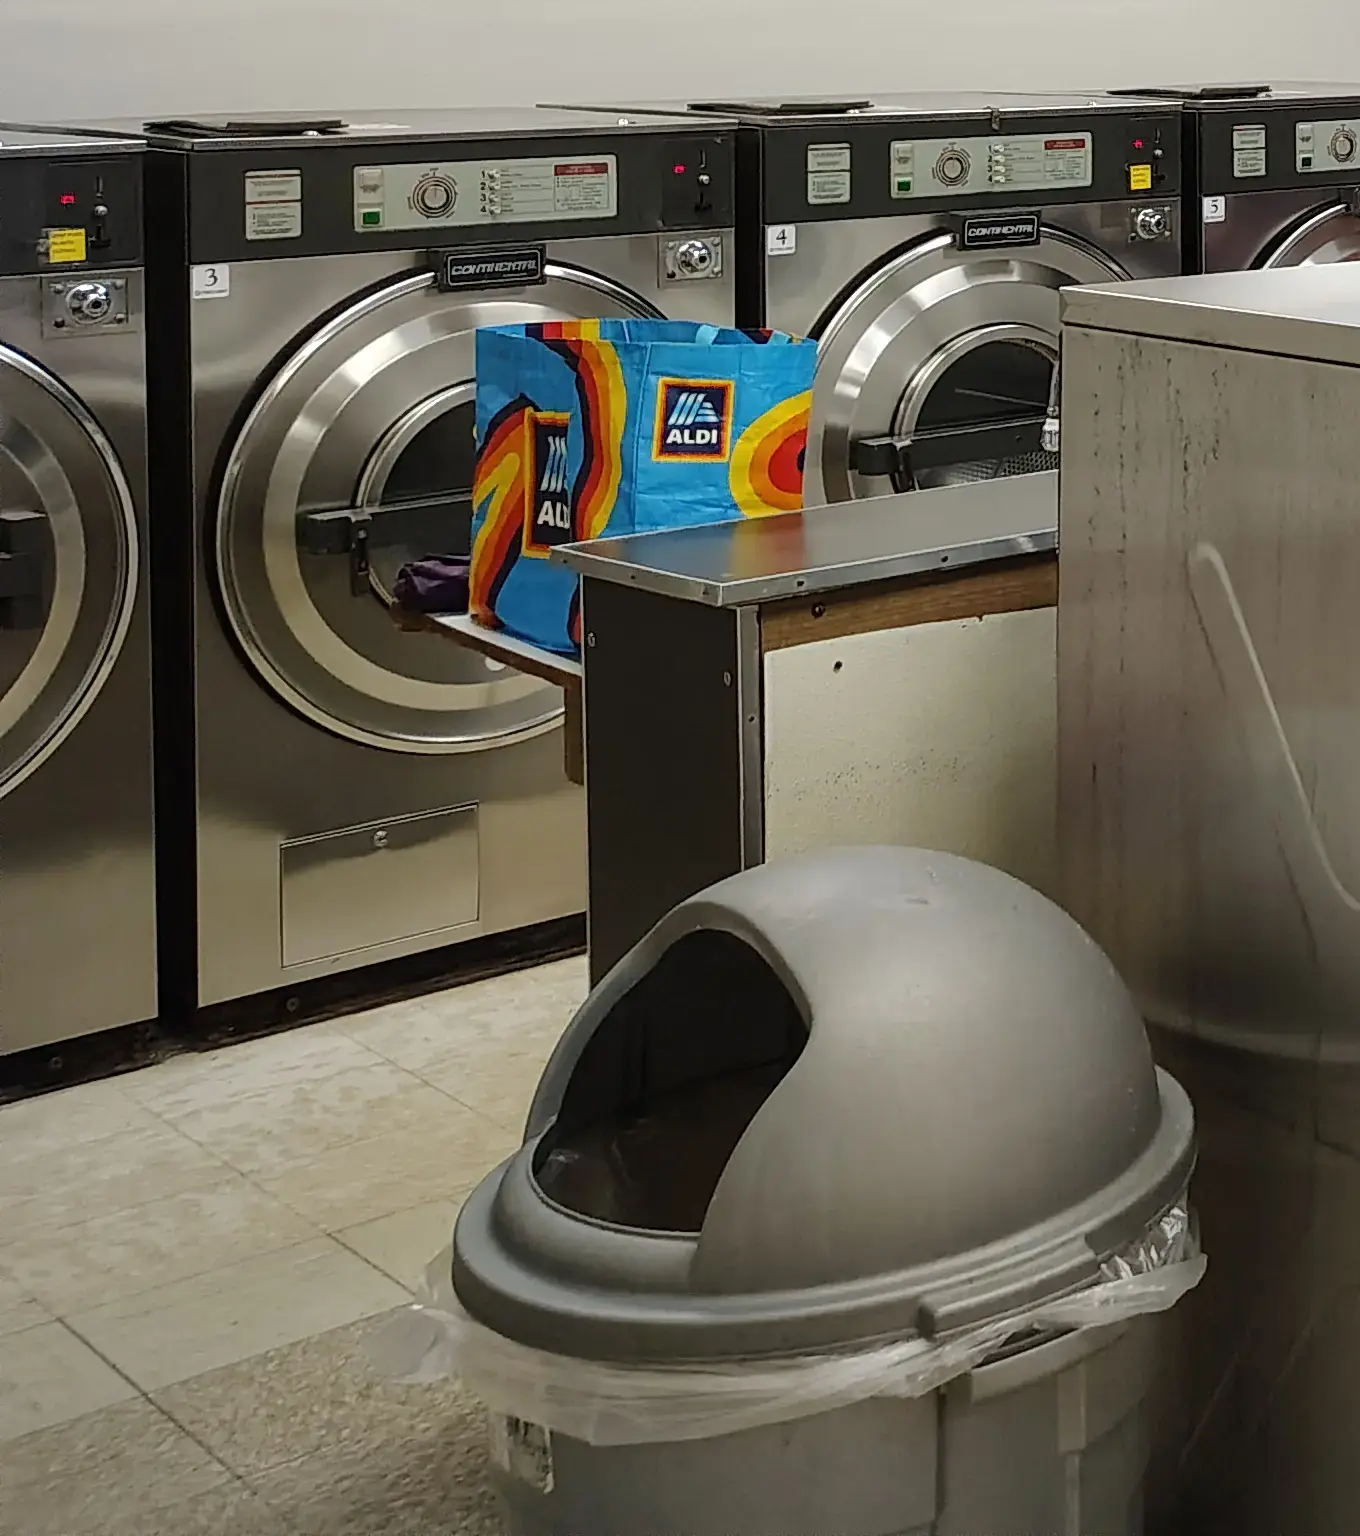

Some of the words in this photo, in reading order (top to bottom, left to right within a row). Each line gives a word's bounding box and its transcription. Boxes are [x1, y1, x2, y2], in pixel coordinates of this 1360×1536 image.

[480, 182, 486, 190] 2
[480, 193, 486, 202] 3
[1210, 199, 1218, 213] 5
[776, 229, 787, 245] 4
[204, 268, 218, 287] 3
[665, 428, 718, 445] ALDI
